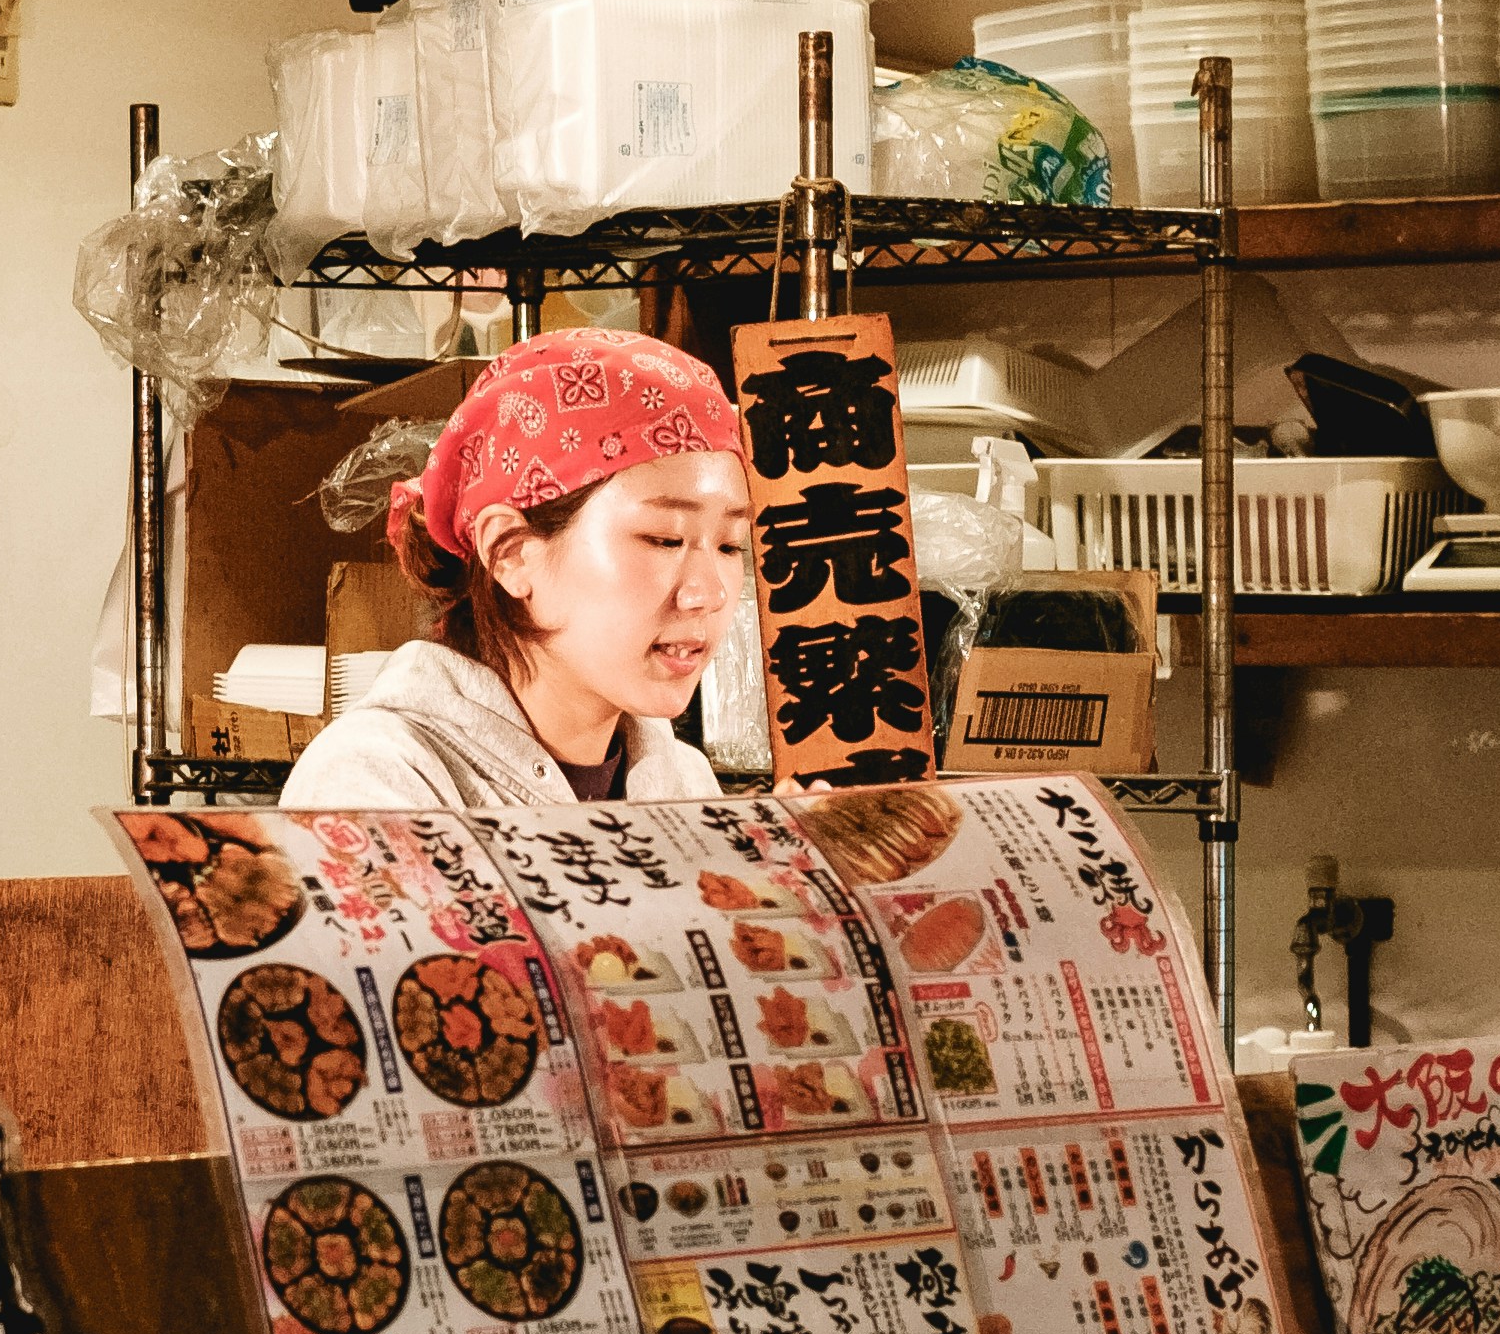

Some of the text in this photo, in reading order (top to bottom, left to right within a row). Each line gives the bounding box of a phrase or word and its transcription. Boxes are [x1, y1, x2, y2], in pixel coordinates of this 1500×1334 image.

[1035, 786, 1153, 914] たこ焼
[1172, 1128, 1260, 1312] からあげ
